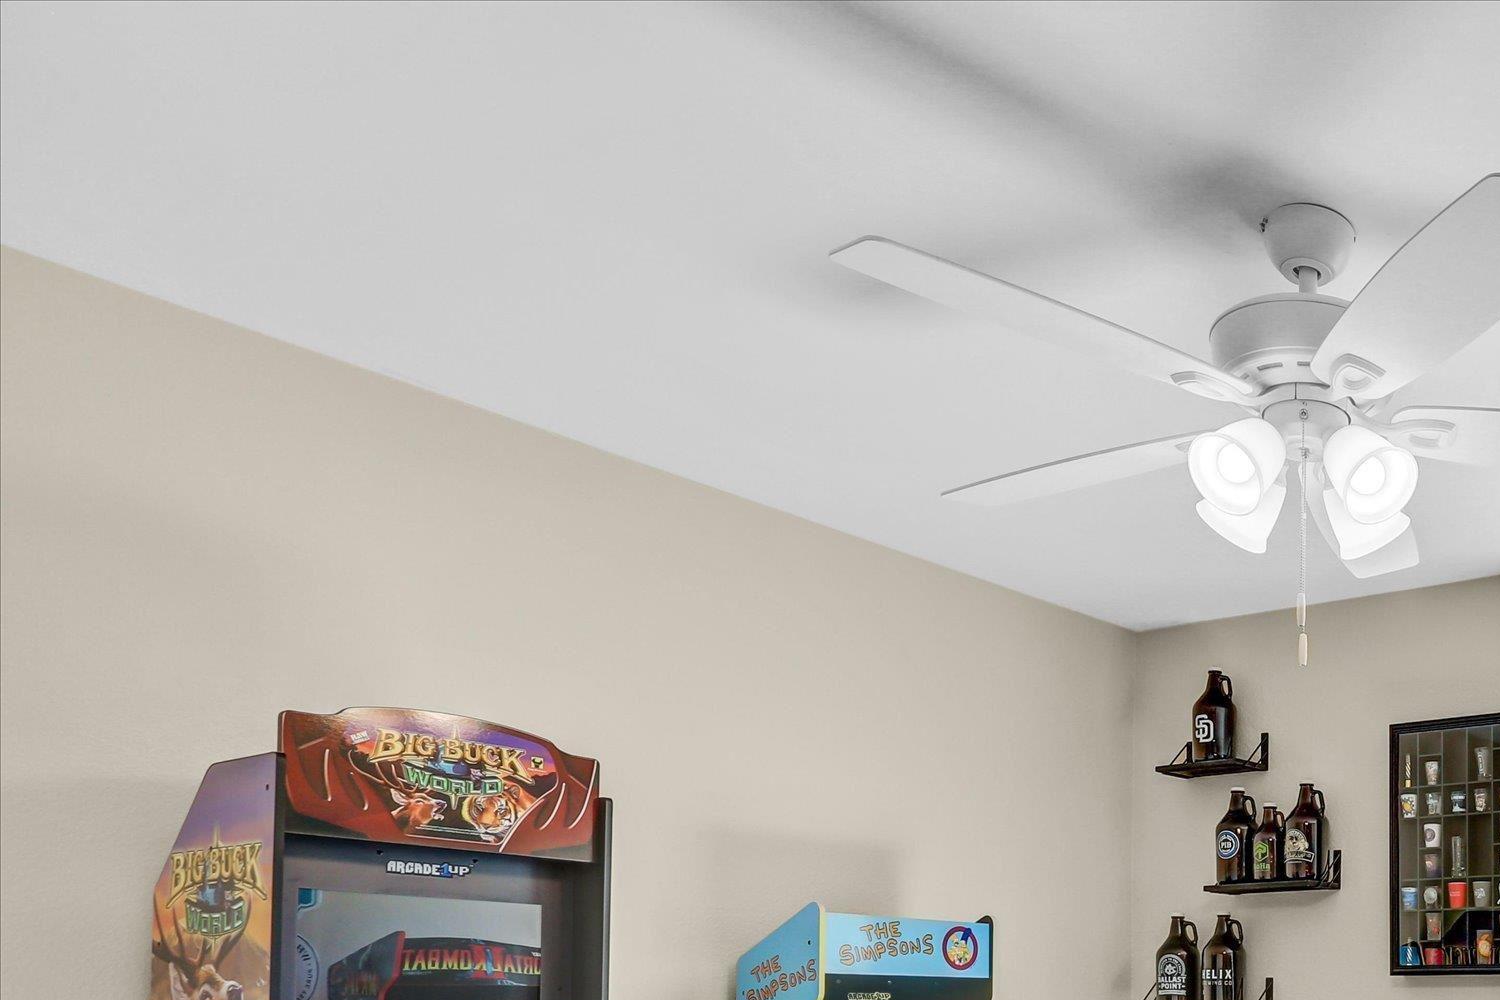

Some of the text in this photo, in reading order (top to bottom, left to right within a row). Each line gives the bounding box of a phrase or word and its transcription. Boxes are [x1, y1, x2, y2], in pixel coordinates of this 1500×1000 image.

[369, 728, 536, 786] BIG BUCK
[404, 766, 503, 797] WORLD
[165, 842, 267, 909] BIG BUCK
[387, 861, 470, 877] ARCADE1UP
[860, 921, 902, 942] THE
[838, 934, 934, 967] SIMPSONS
[751, 955, 782, 983] THE
